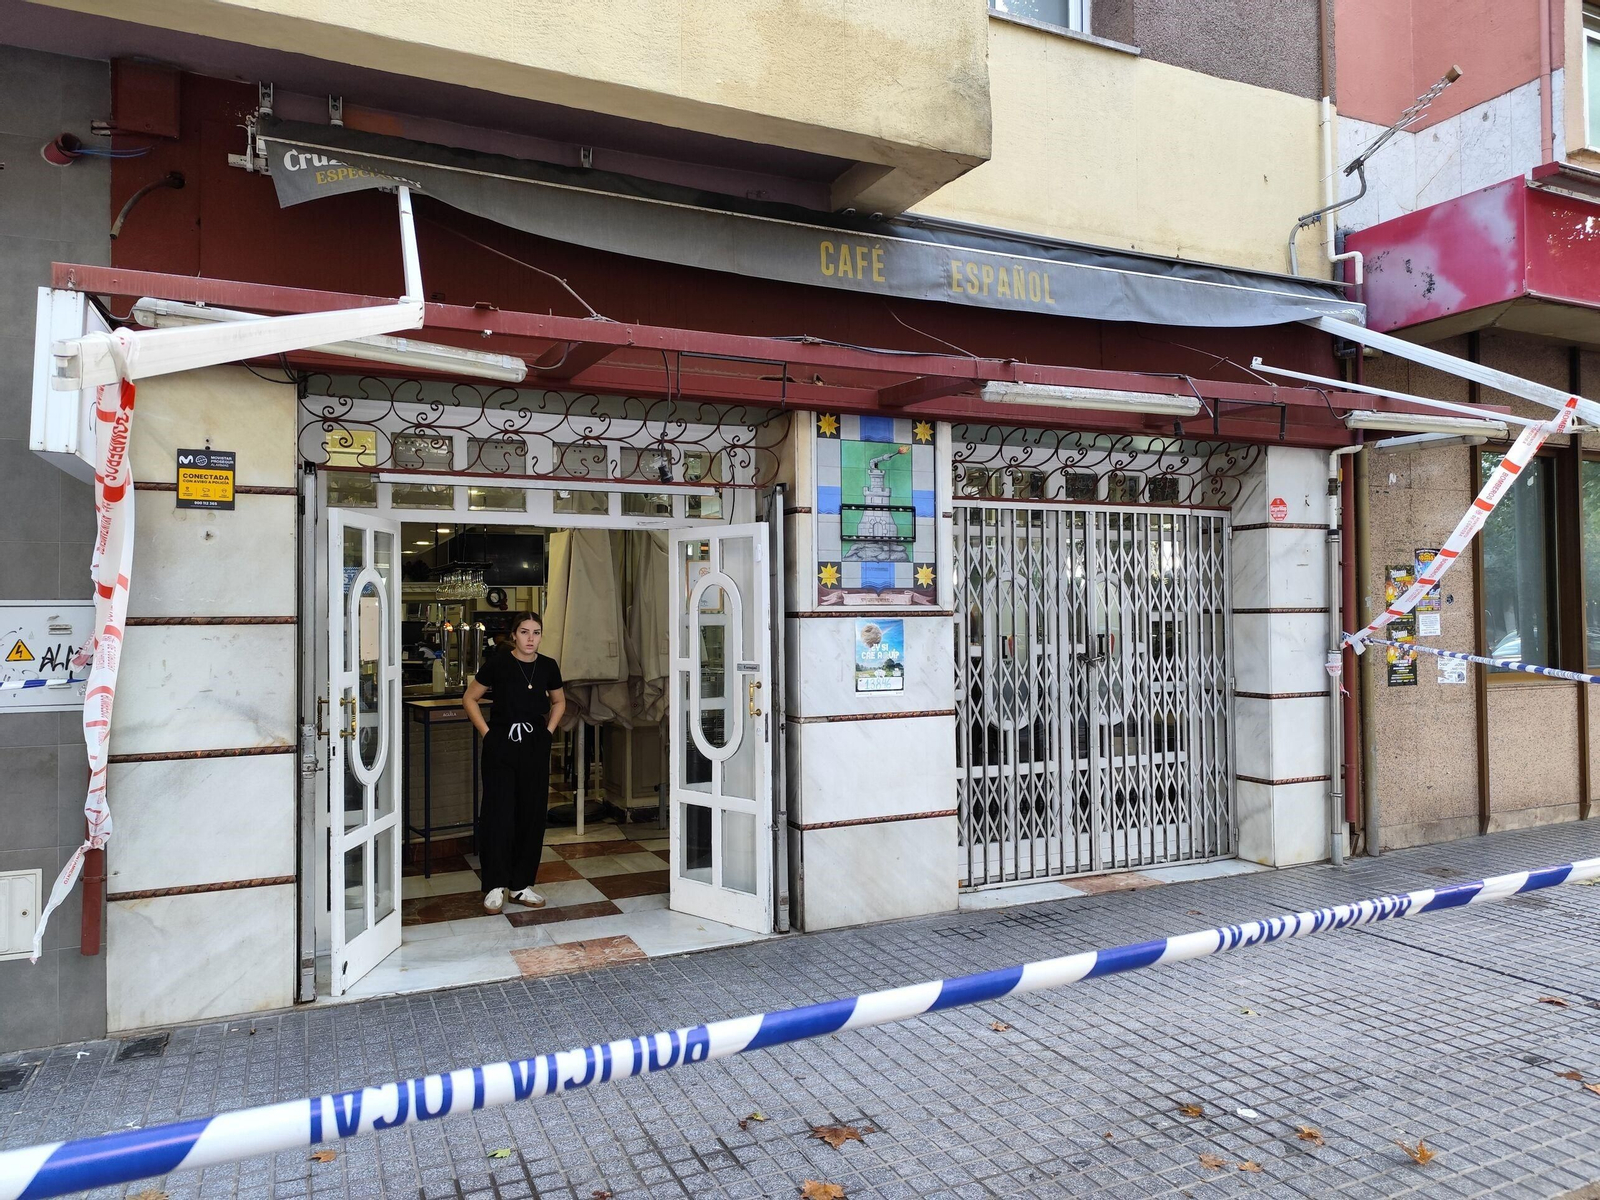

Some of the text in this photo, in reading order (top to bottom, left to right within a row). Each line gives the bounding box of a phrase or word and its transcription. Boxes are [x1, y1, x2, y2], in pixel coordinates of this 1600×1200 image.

[820, 240, 1057, 305] CAFÉ ESPAÑOL
[1486, 471, 1509, 501] BOMBEROS
[861, 651, 876, 660] CAE
[881, 643, 889, 652] SI
